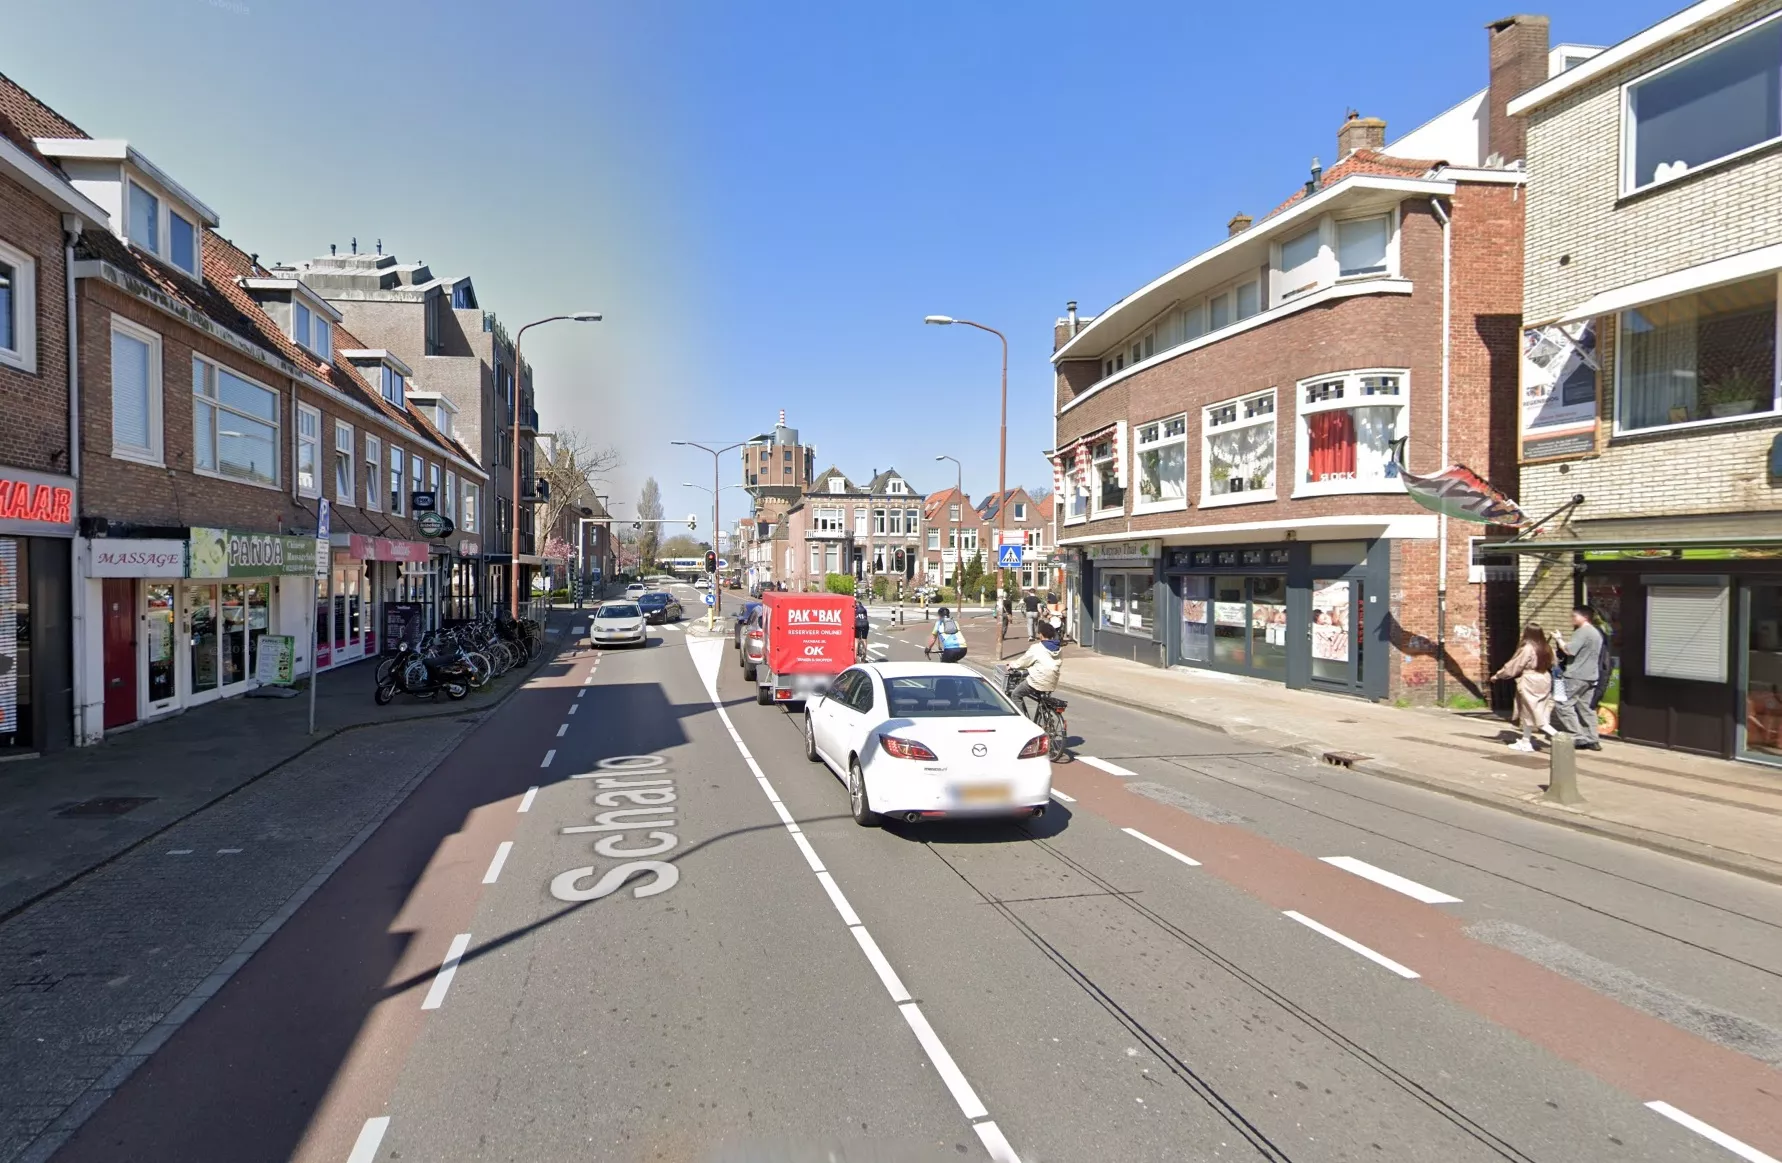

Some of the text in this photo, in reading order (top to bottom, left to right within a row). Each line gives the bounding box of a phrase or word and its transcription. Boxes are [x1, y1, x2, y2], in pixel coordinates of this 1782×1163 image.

[229, 535, 284, 566] PANDA
[98, 552, 179, 568] MASSAGE
[788, 609, 811, 623] PAK
[818, 609, 842, 623] BAK
[804, 646, 824, 656] OK
